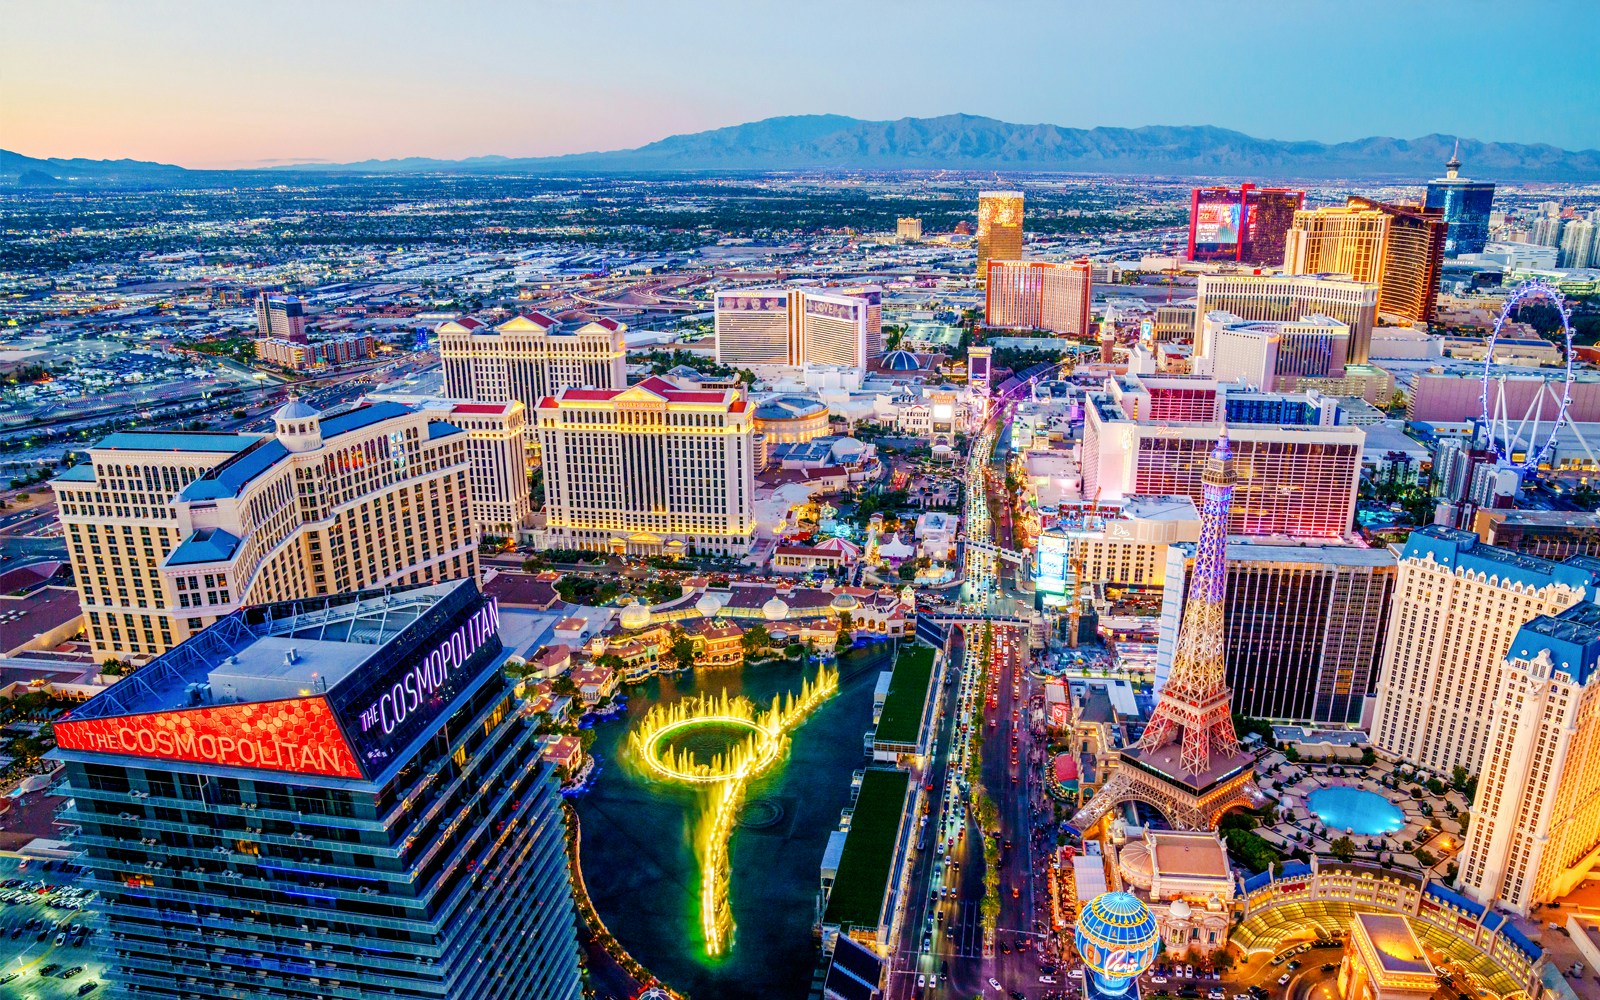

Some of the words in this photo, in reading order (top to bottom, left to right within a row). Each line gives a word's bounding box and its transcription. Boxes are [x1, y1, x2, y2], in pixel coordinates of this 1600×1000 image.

[814, 303, 834, 314] LOVE
[360, 703, 380, 732] THE
[379, 597, 500, 735] COSMOPOLITAN
[85, 732, 118, 750] THE
[118, 727, 340, 772] COSMOPOLITAN
[1104, 949, 1139, 980] Paris
